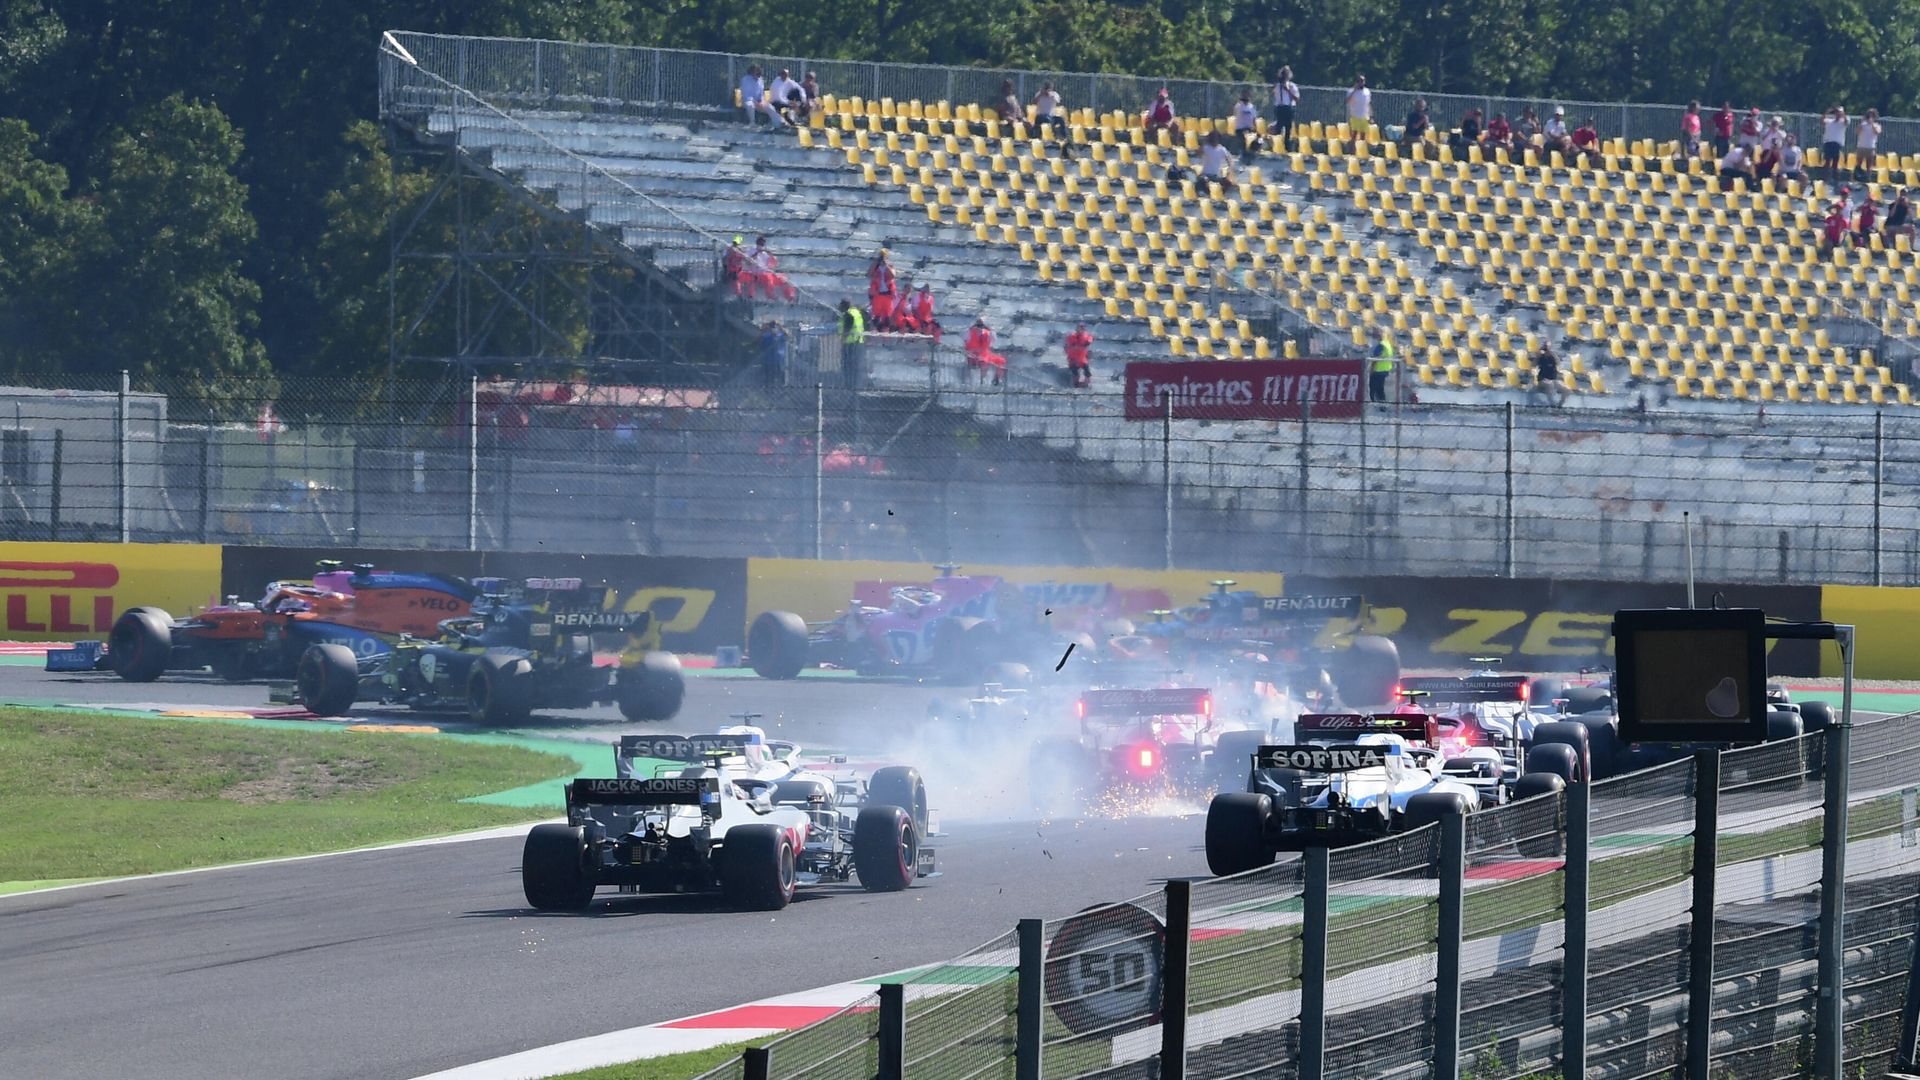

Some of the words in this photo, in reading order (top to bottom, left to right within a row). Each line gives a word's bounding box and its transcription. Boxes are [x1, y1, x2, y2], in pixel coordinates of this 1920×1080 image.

[1135, 376, 1252, 408] Emirates
[1262, 375, 1294, 404] FLY
[1299, 374, 1359, 404] BETTER
[419, 597, 459, 611] VELO
[1263, 597, 1352, 611] RENAULT
[554, 613, 641, 626] RENAULT
[1319, 716, 1356, 730] Alfa
[634, 740, 738, 758] SOFINA
[1272, 749, 1382, 769] SOFINA
